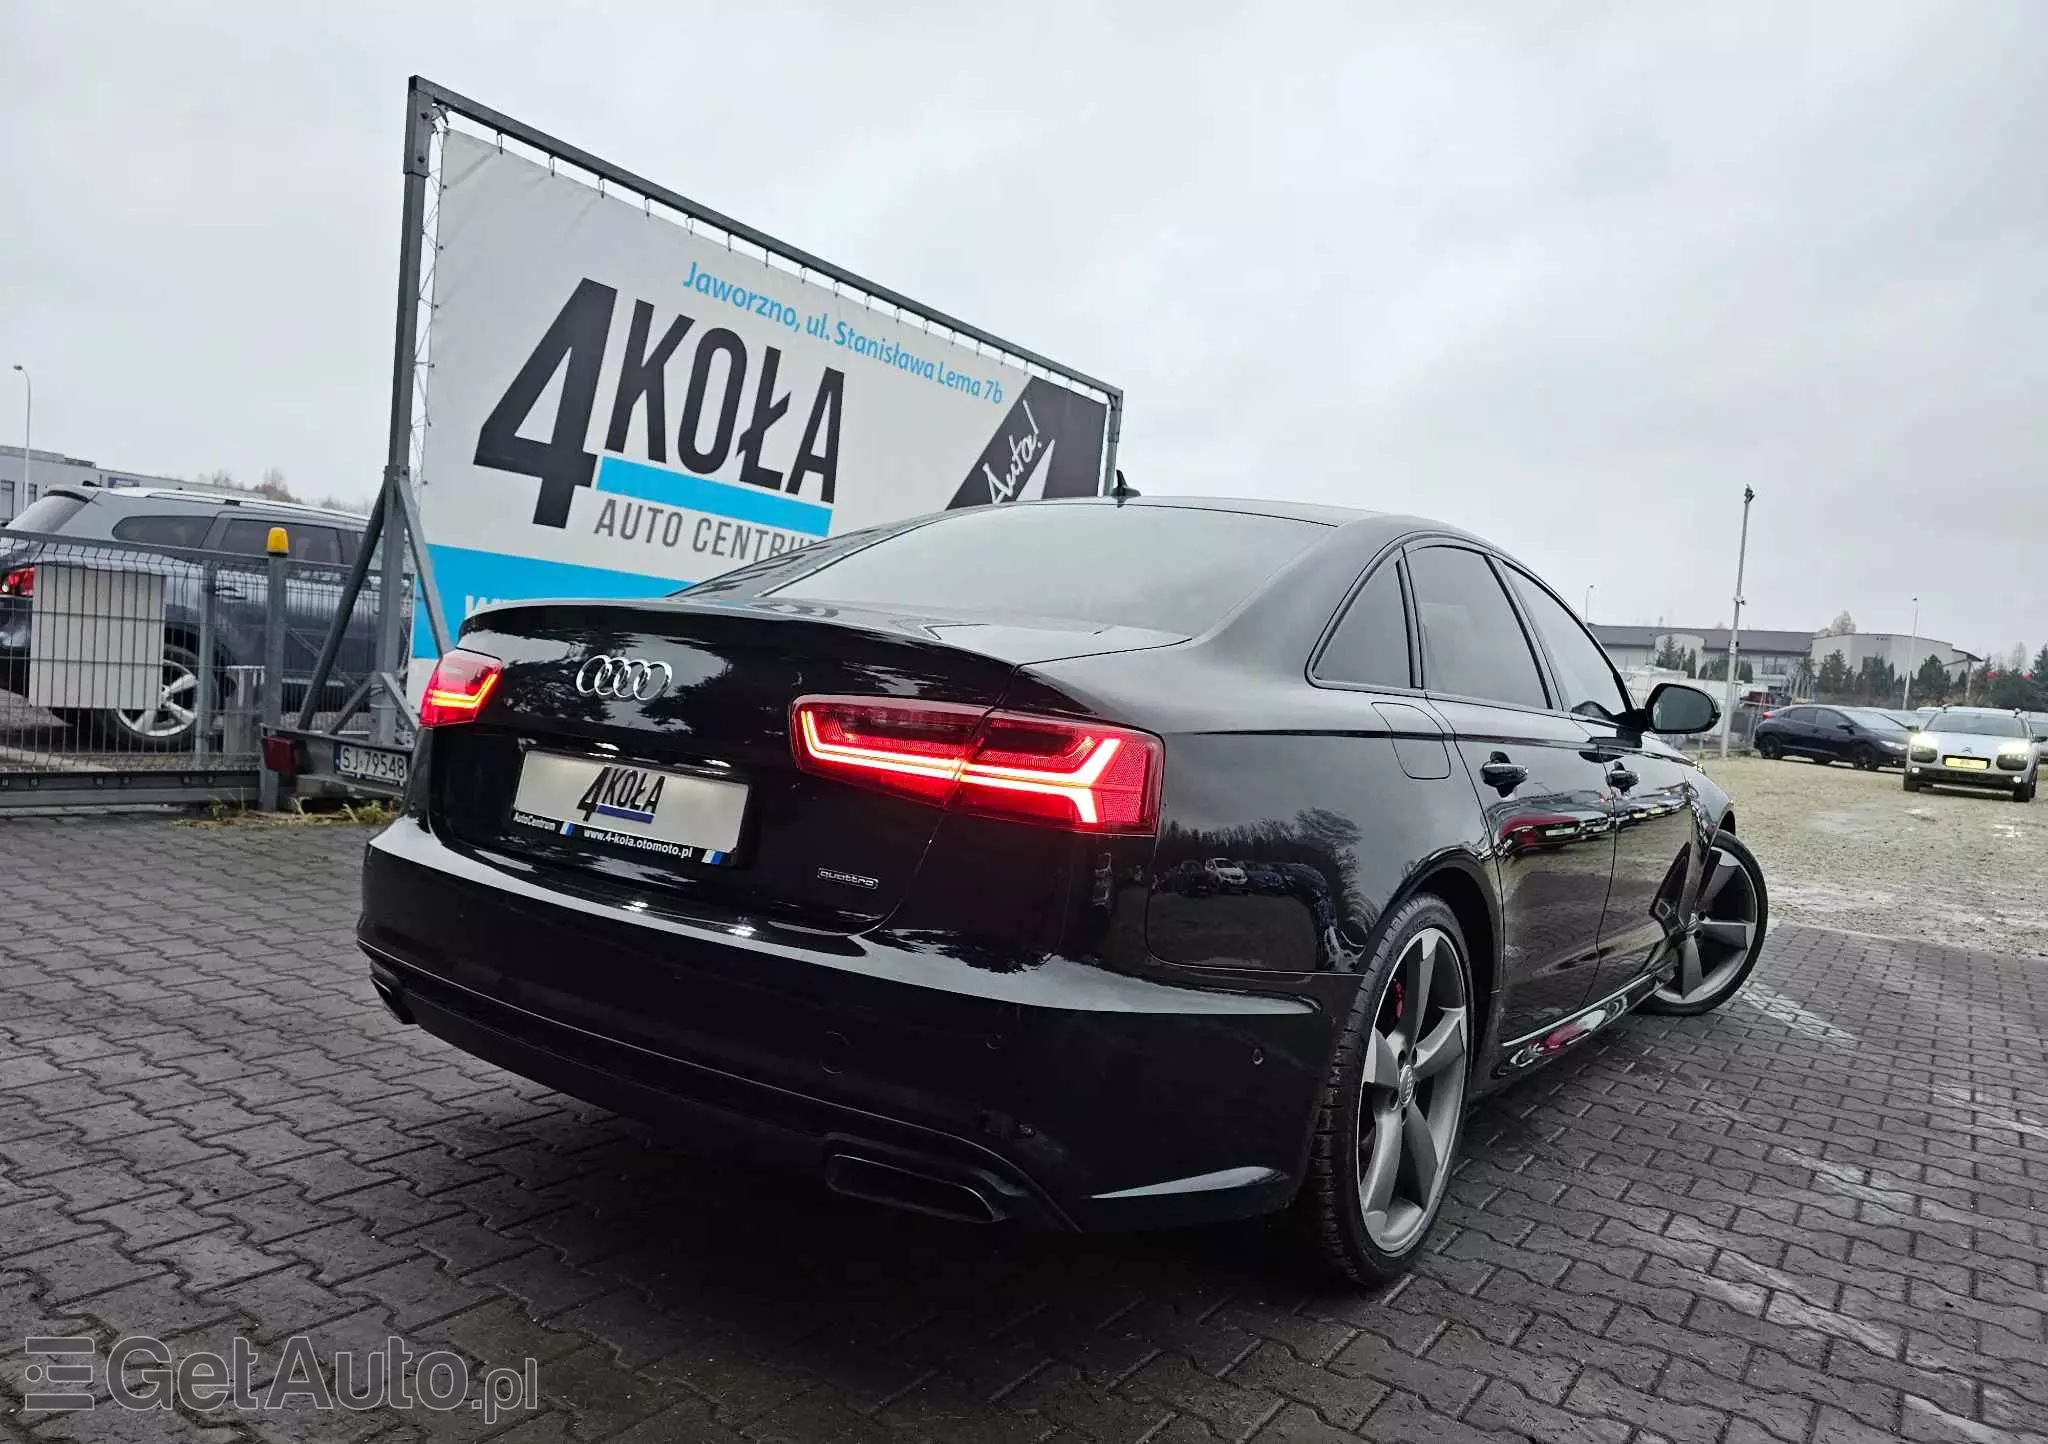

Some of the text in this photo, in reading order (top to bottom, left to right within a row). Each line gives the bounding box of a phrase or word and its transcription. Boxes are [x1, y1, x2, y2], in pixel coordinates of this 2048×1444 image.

[683, 261, 1003, 405] Jaworzno, ul. Stanisława Lema 7b
[593, 498, 683, 548] AUTO
[343, 747, 405, 779] SJ 79548
[820, 870, 874, 887] quattro
